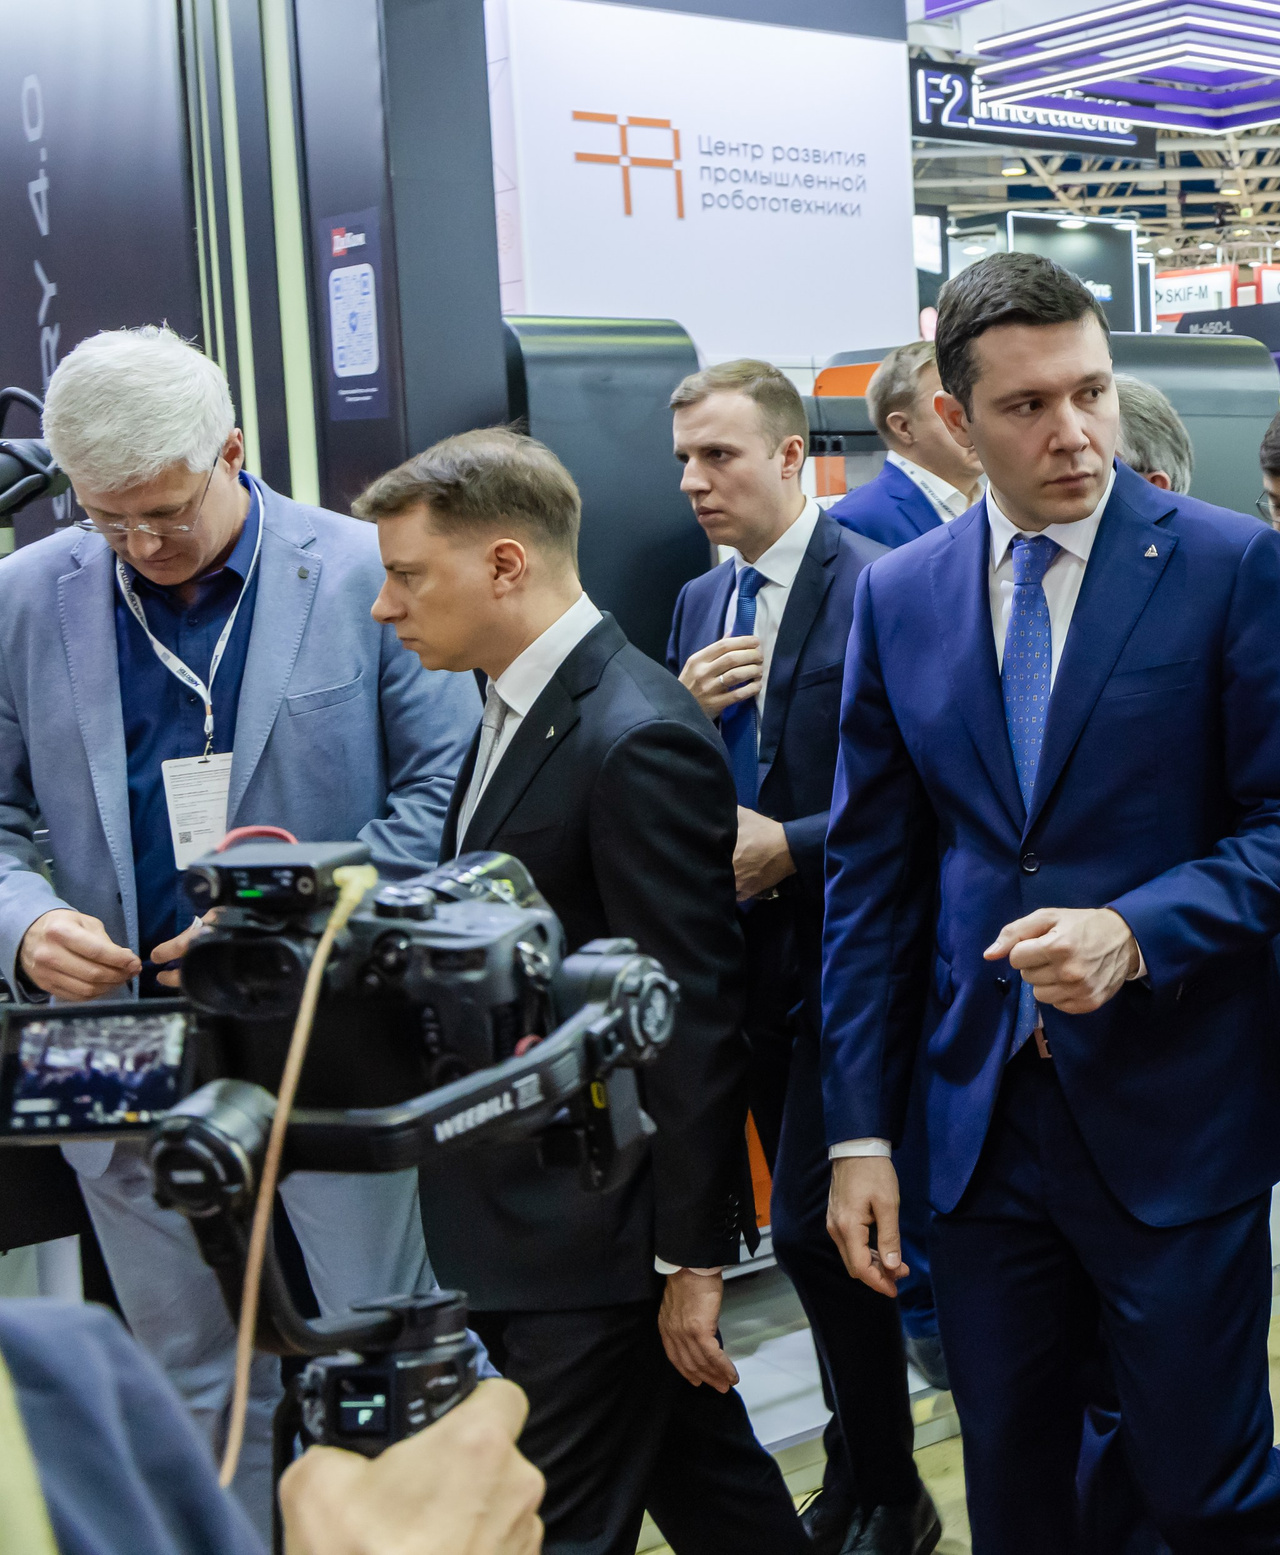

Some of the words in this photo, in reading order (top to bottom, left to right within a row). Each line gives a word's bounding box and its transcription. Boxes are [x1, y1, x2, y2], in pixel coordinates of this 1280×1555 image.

[21, 73, 50, 236] 4.0
[698, 135, 764, 162] Центр
[772, 146, 867, 168] развития
[700, 166, 867, 193] промышленной
[702, 189, 862, 216] робототехники
[1165, 285, 1208, 303] SKIF-M
